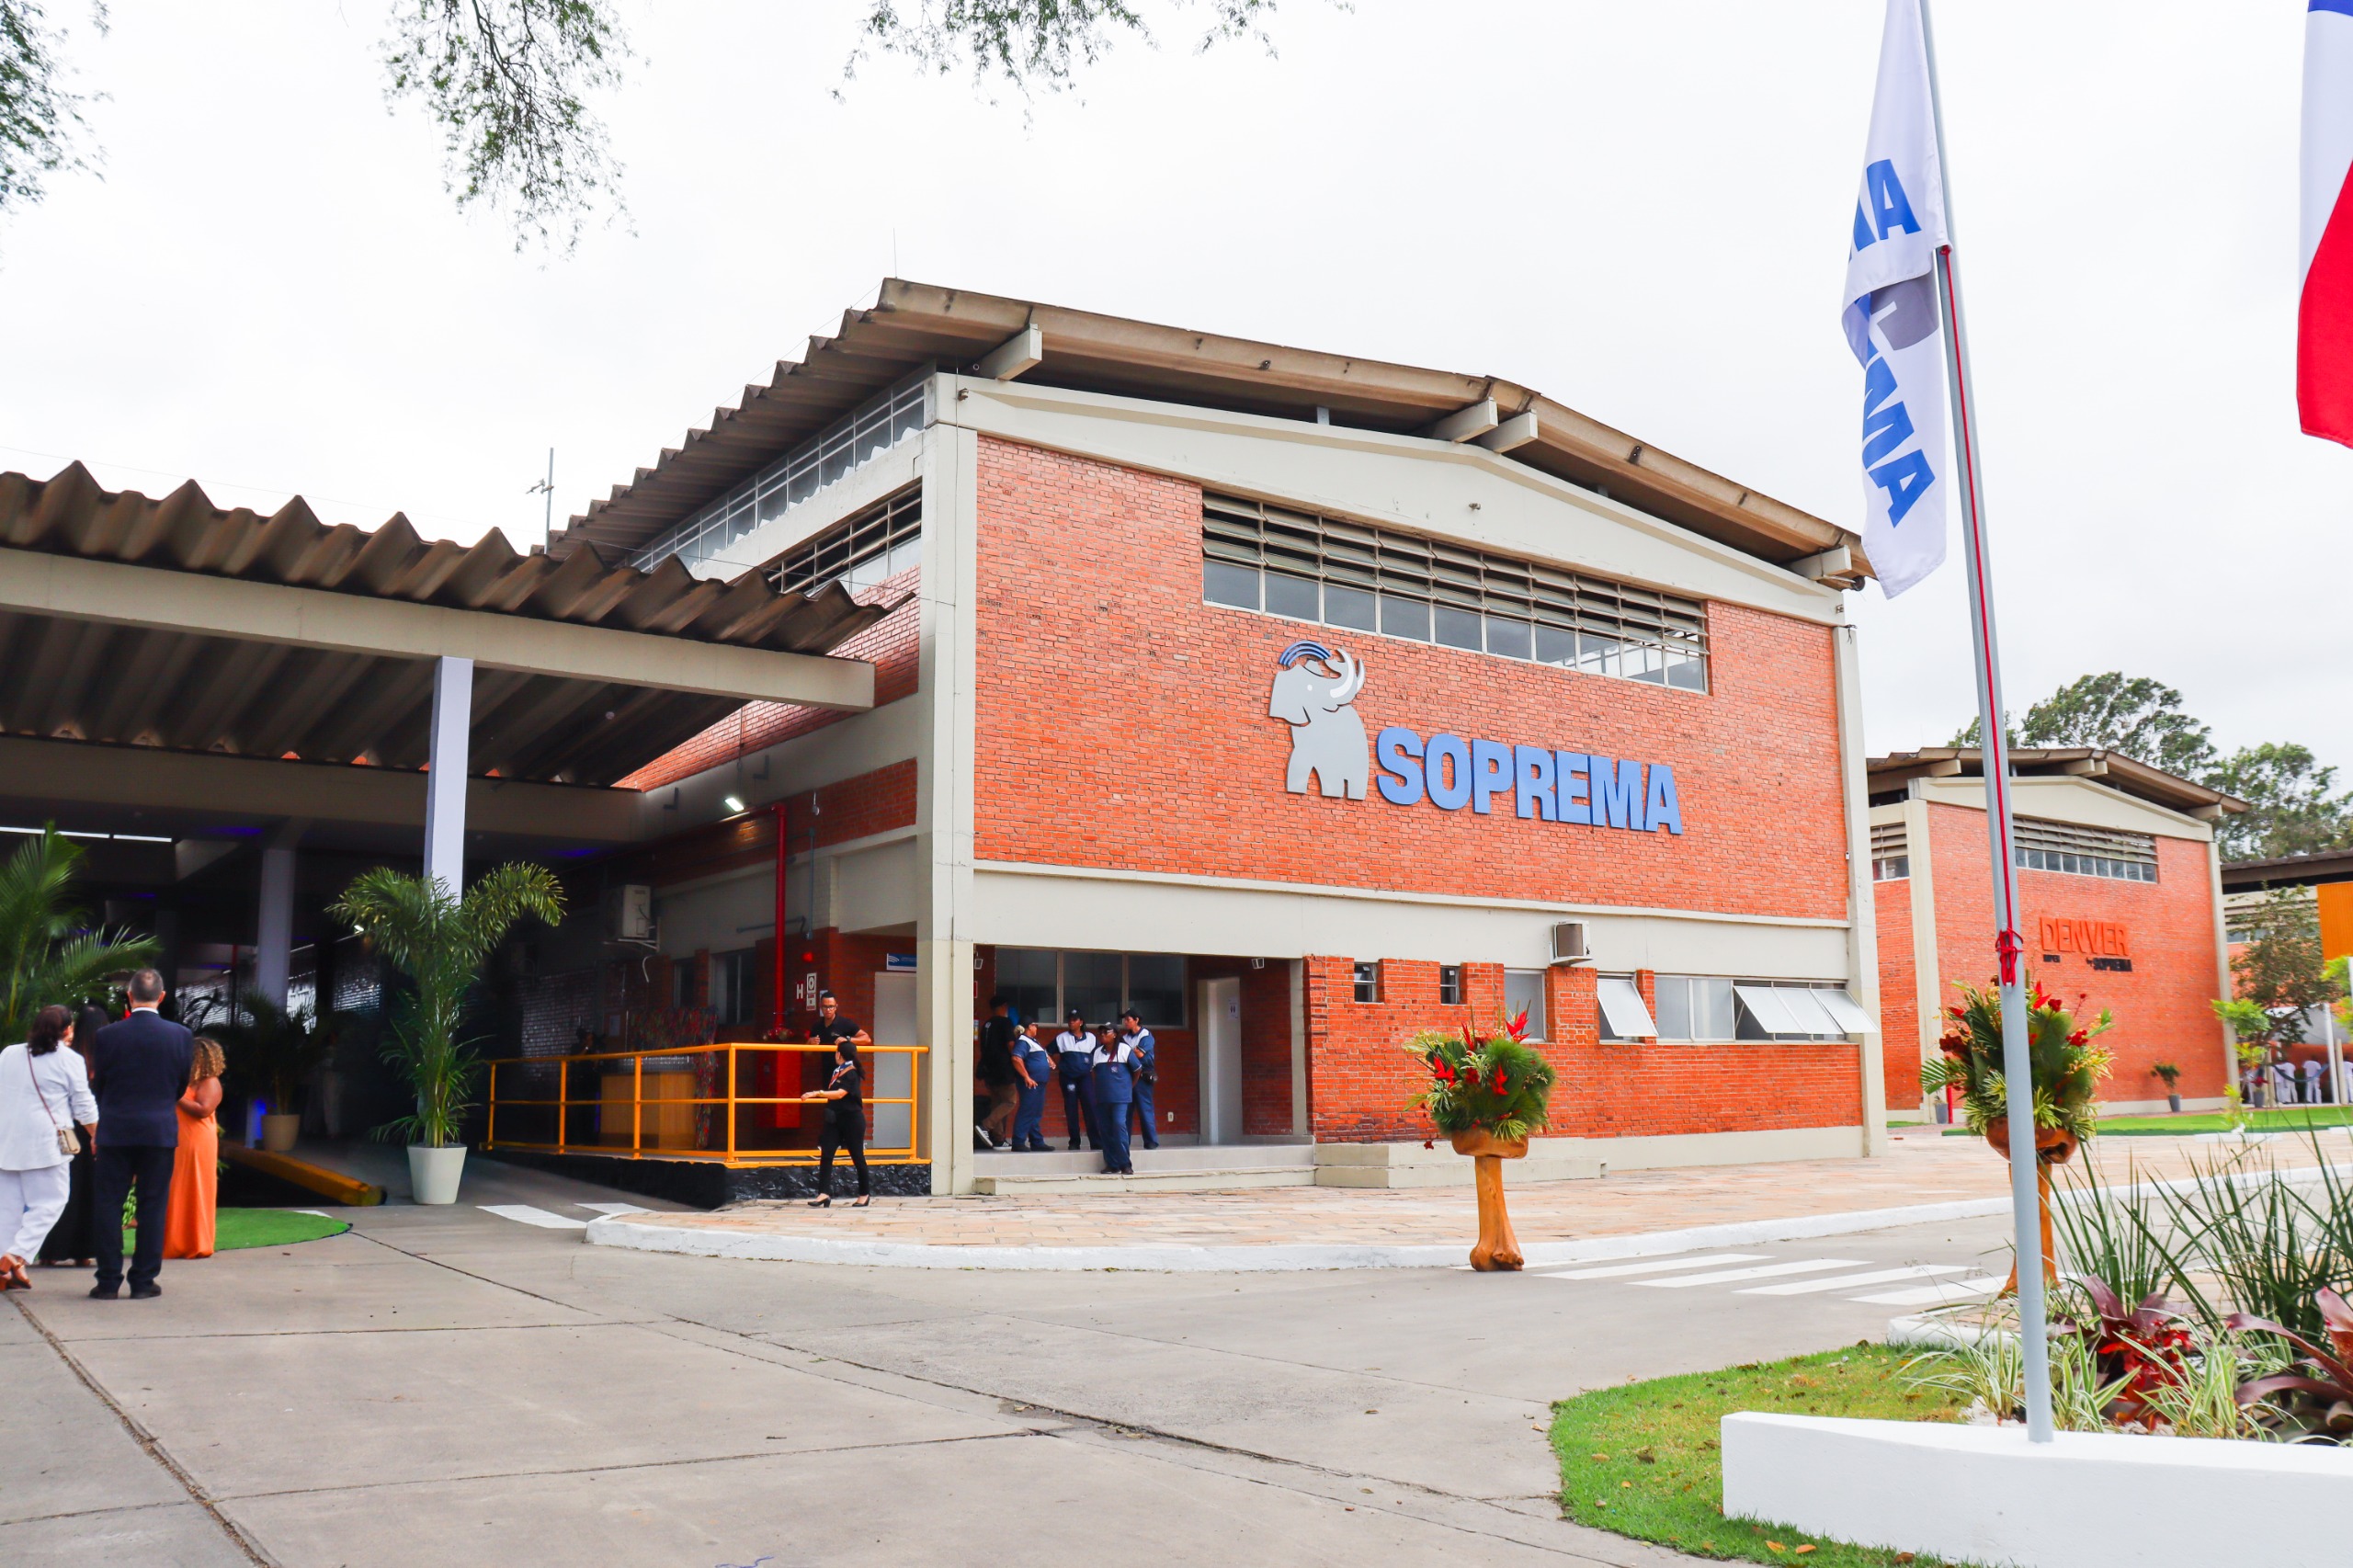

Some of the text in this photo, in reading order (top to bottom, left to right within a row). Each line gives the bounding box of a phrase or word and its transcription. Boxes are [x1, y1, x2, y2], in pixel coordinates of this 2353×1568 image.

[1376, 726, 1683, 835] SOPREMA
[2040, 917, 2129, 956] DENVER
[796, 983, 804, 1000] H
